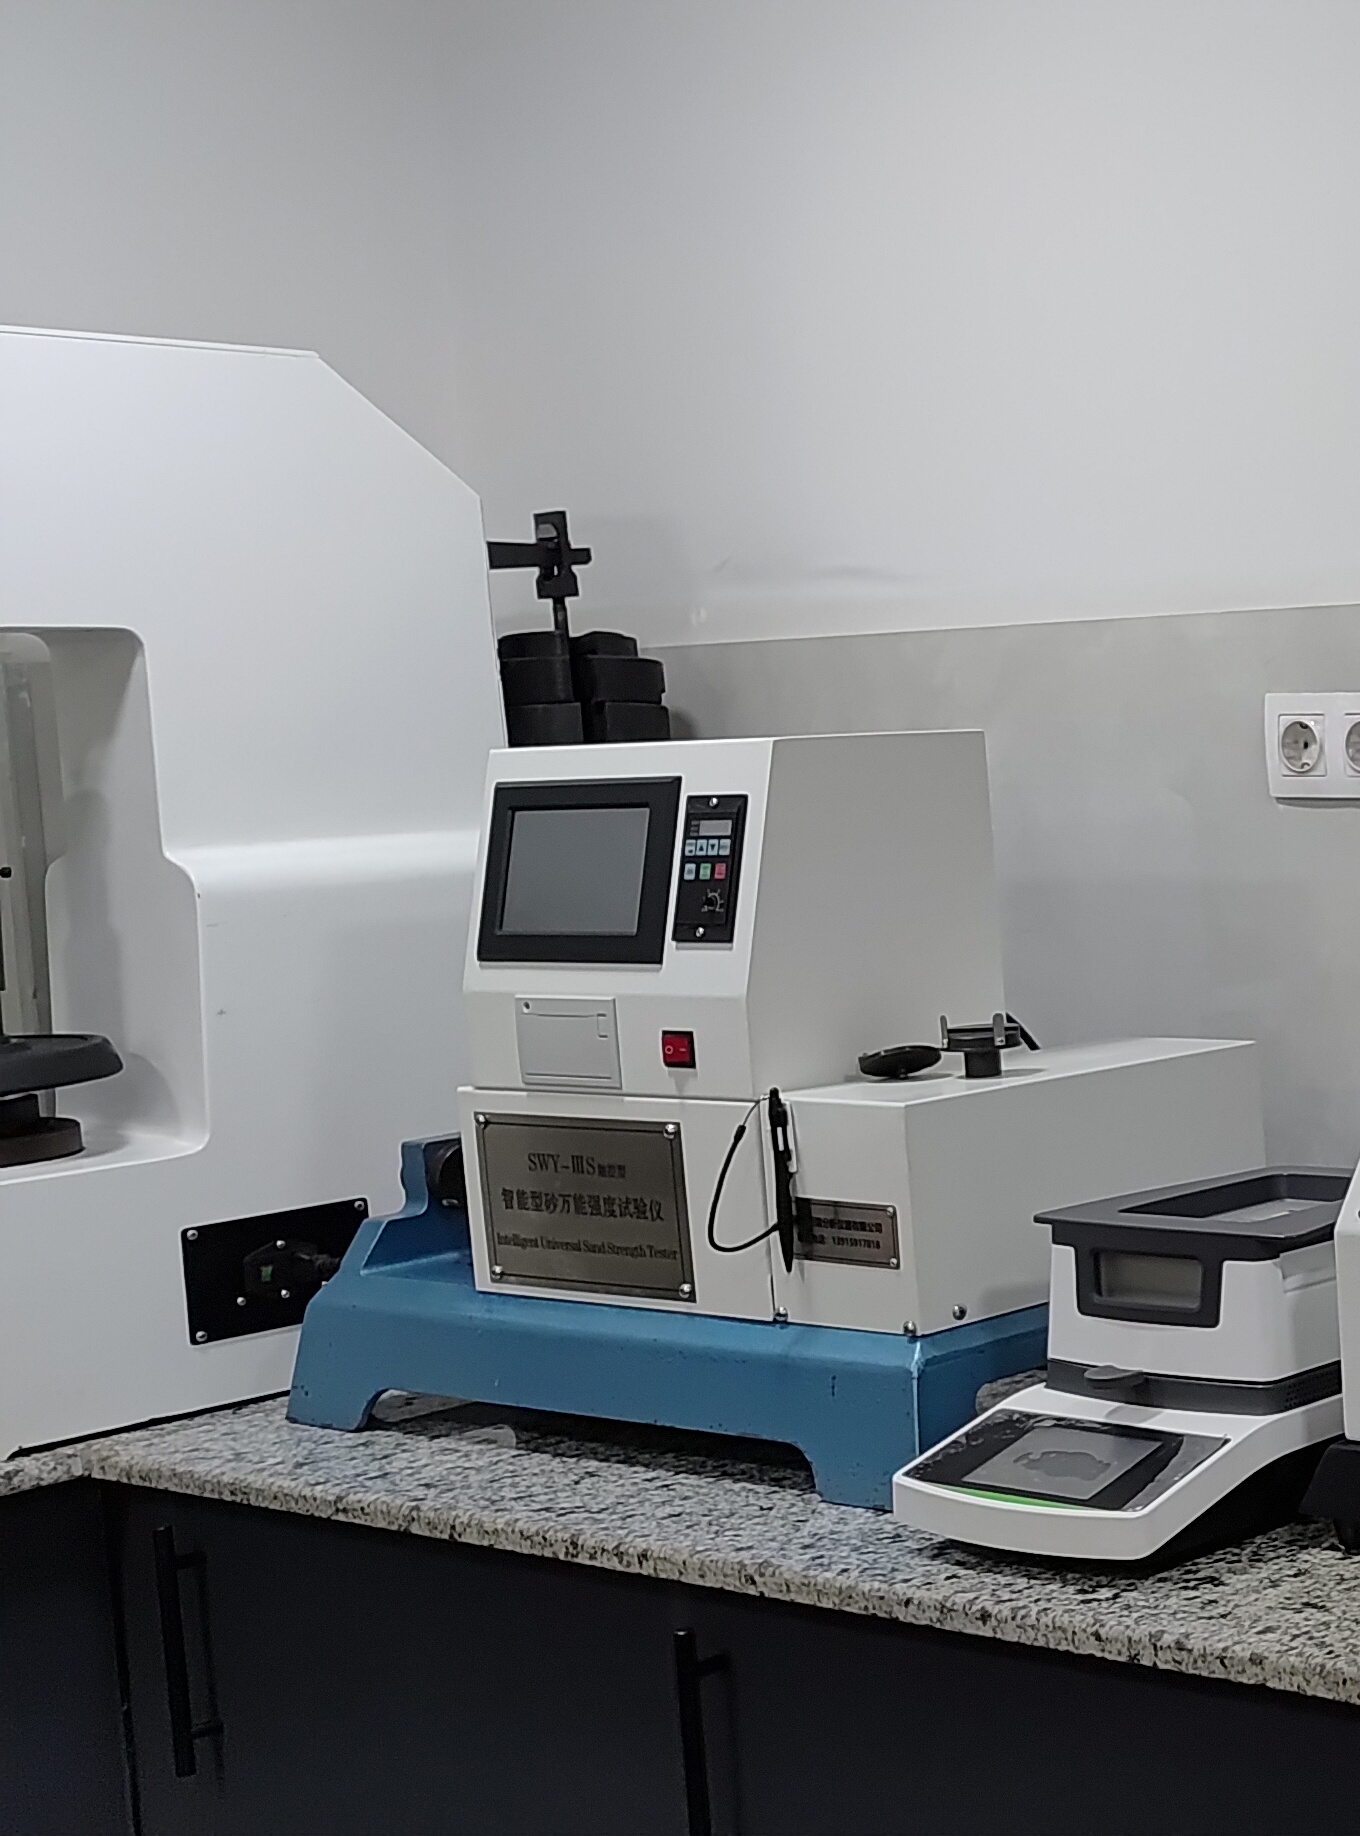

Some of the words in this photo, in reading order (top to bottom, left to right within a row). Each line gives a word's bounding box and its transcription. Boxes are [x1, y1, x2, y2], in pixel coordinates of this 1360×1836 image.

[502, 1188, 665, 1222] 智能型砂万能强度试验仪
[497, 1232, 539, 1250] Intelligent
[540, 1236, 581, 1252] Universal
[583, 1240, 605, 1254] Sand
[607, 1242, 646, 1260] Strength
[648, 1246, 678, 1260] Tester
